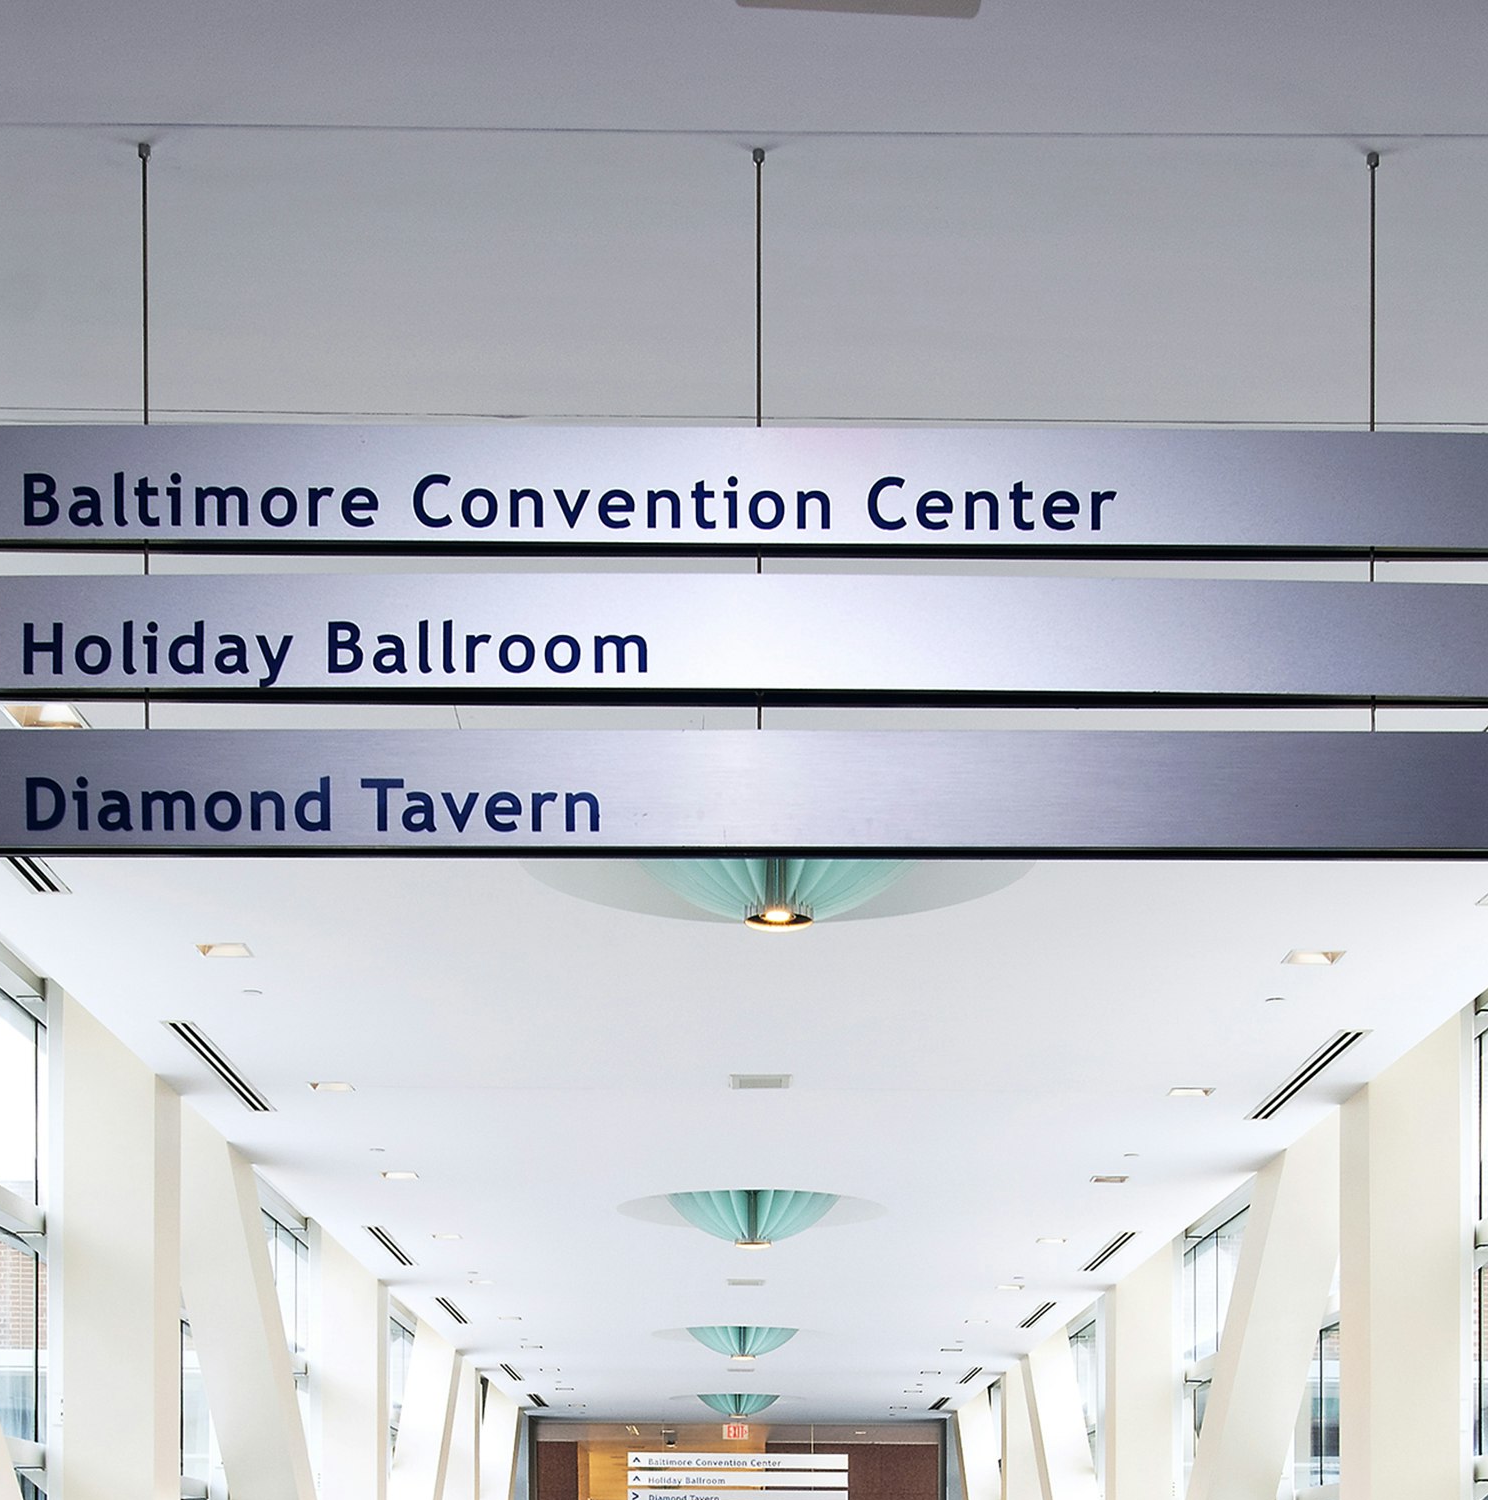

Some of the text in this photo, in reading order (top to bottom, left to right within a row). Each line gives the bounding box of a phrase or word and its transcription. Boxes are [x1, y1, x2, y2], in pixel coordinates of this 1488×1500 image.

[23, 471, 1118, 531] Baltimore Convention Center
[23, 620, 648, 688] Holiday Ballroom
[24, 776, 600, 834] Diamond Tavern
[727, 1425, 744, 1438] EXIT
[648, 1458, 782, 1467] Baltimore Convention Center
[648, 1477, 726, 1487] Holiday Ballroom
